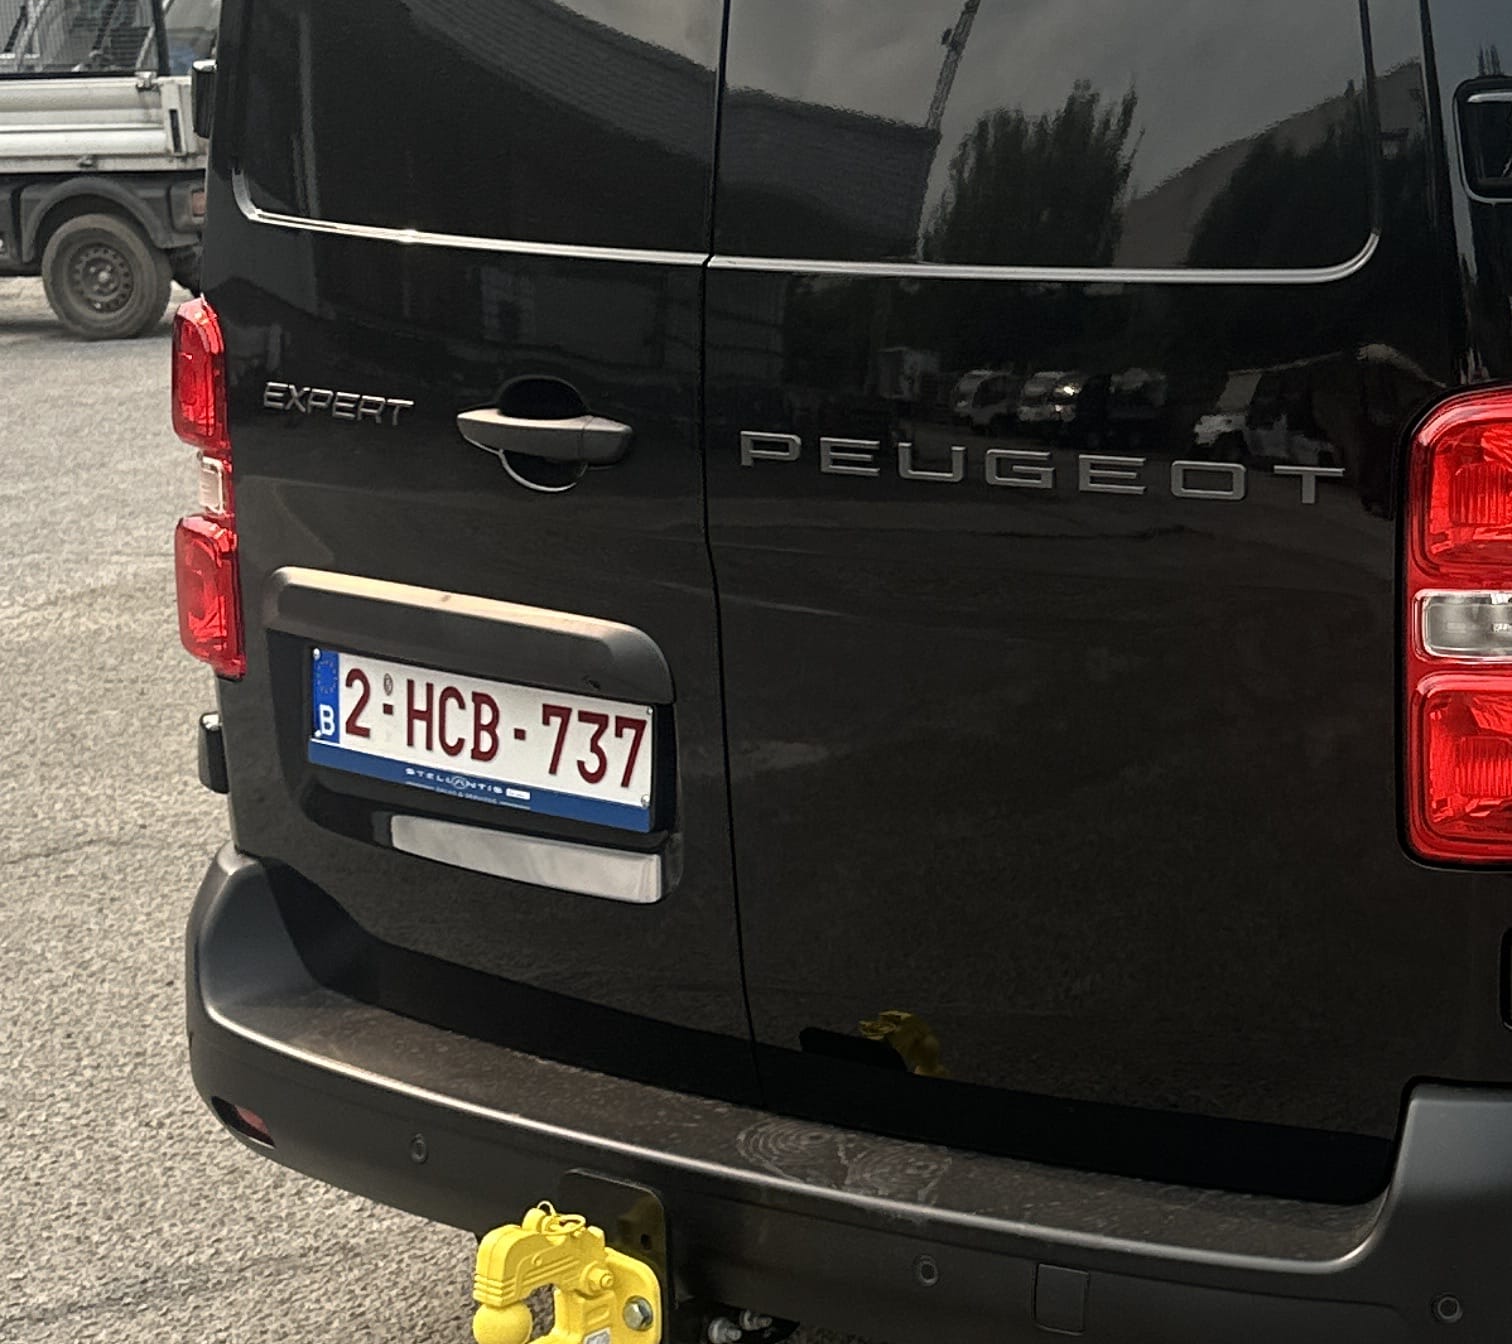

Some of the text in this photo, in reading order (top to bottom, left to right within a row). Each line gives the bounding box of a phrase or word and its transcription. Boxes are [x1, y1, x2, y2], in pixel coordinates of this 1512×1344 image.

[263, 381, 415, 426] EXPERT
[740, 430, 1346, 505] PEUGEOT
[319, 704, 336, 737] B
